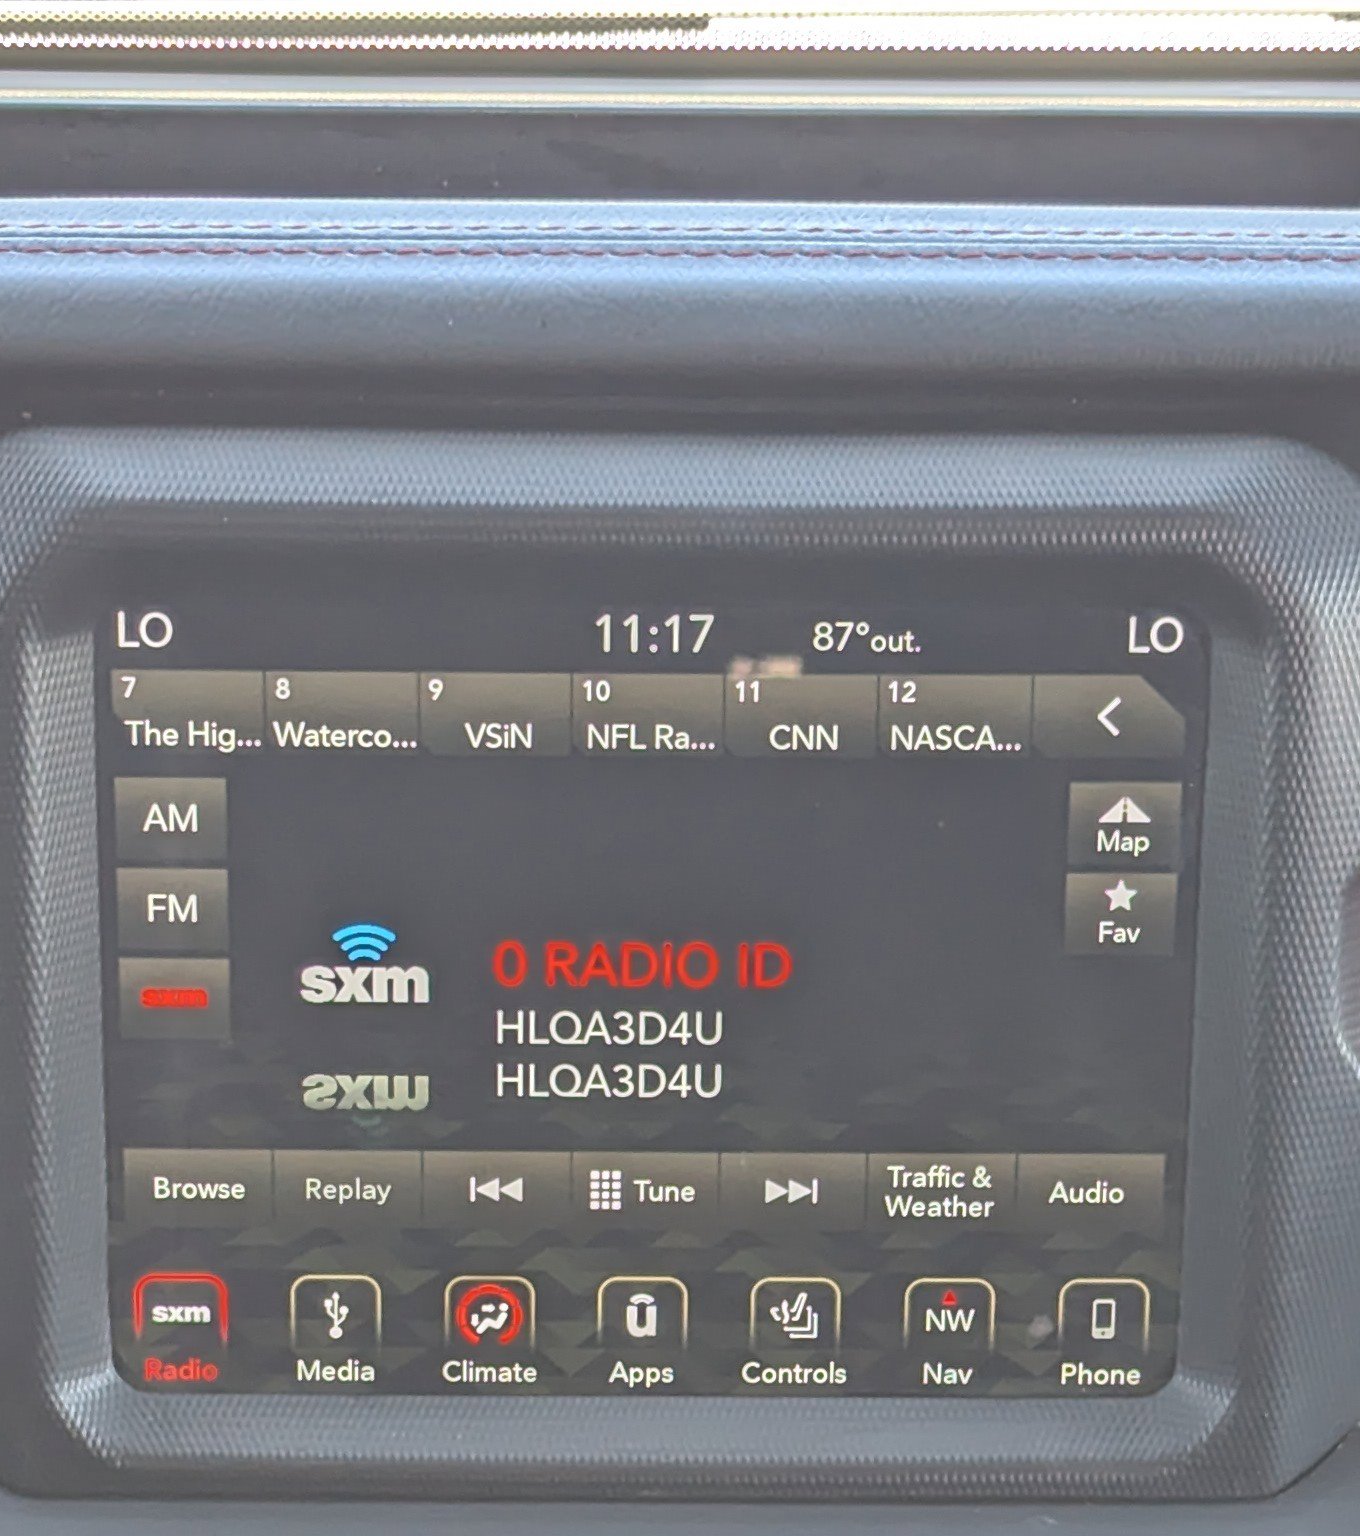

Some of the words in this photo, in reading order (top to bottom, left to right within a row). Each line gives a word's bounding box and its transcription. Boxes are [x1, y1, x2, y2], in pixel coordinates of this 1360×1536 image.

[116, 611, 173, 648] LO
[595, 614, 715, 654] 11:17
[1128, 617, 1184, 654] LO
[120, 678, 136, 698] 7
[275, 679, 291, 699] 8
[428, 680, 443, 700] 9
[583, 681, 610, 701] 10
[735, 682, 760, 703] 11
[888, 683, 916, 703] 12
[126, 722, 178, 747] The
[187, 722, 262, 752] Hig...
[274, 723, 417, 749] Waterco...
[465, 724, 533, 749] VSiN
[587, 724, 645, 750] NFL
[655, 725, 715, 751] Ra...
[769, 725, 839, 751] CNN
[890, 726, 1021, 752] NASCA...
[143, 804, 198, 833] AM
[1097, 831, 1150, 856] Map
[147, 895, 198, 924] FM
[1098, 922, 1140, 944] Fav
[493, 940, 527, 987] 0
[546, 940, 719, 989] RADIO
[738, 942, 793, 989] ID
[300, 965, 430, 1003] sxm
[496, 1010, 723, 1046] HLQA3D4U
[496, 1063, 723, 1099] HLQA3D4U
[888, 1165, 964, 1189] Traffic
[972, 1167, 992, 1189] &
[153, 1178, 245, 1201] Browse
[306, 1178, 391, 1205] Replay
[634, 1180, 695, 1203] Tune
[1049, 1182, 1124, 1204] Audio
[886, 1195, 994, 1218] Weather
[152, 1303, 210, 1323] sxm
[925, 1310, 975, 1332] NW
[145, 1359, 218, 1382] Radio
[297, 1361, 375, 1383] Media
[443, 1361, 537, 1383] Climate
[609, 1362, 674, 1387] Apps
[742, 1363, 846, 1384] Controls
[923, 1364, 973, 1384] Nav
[1061, 1364, 1141, 1385] Phone
